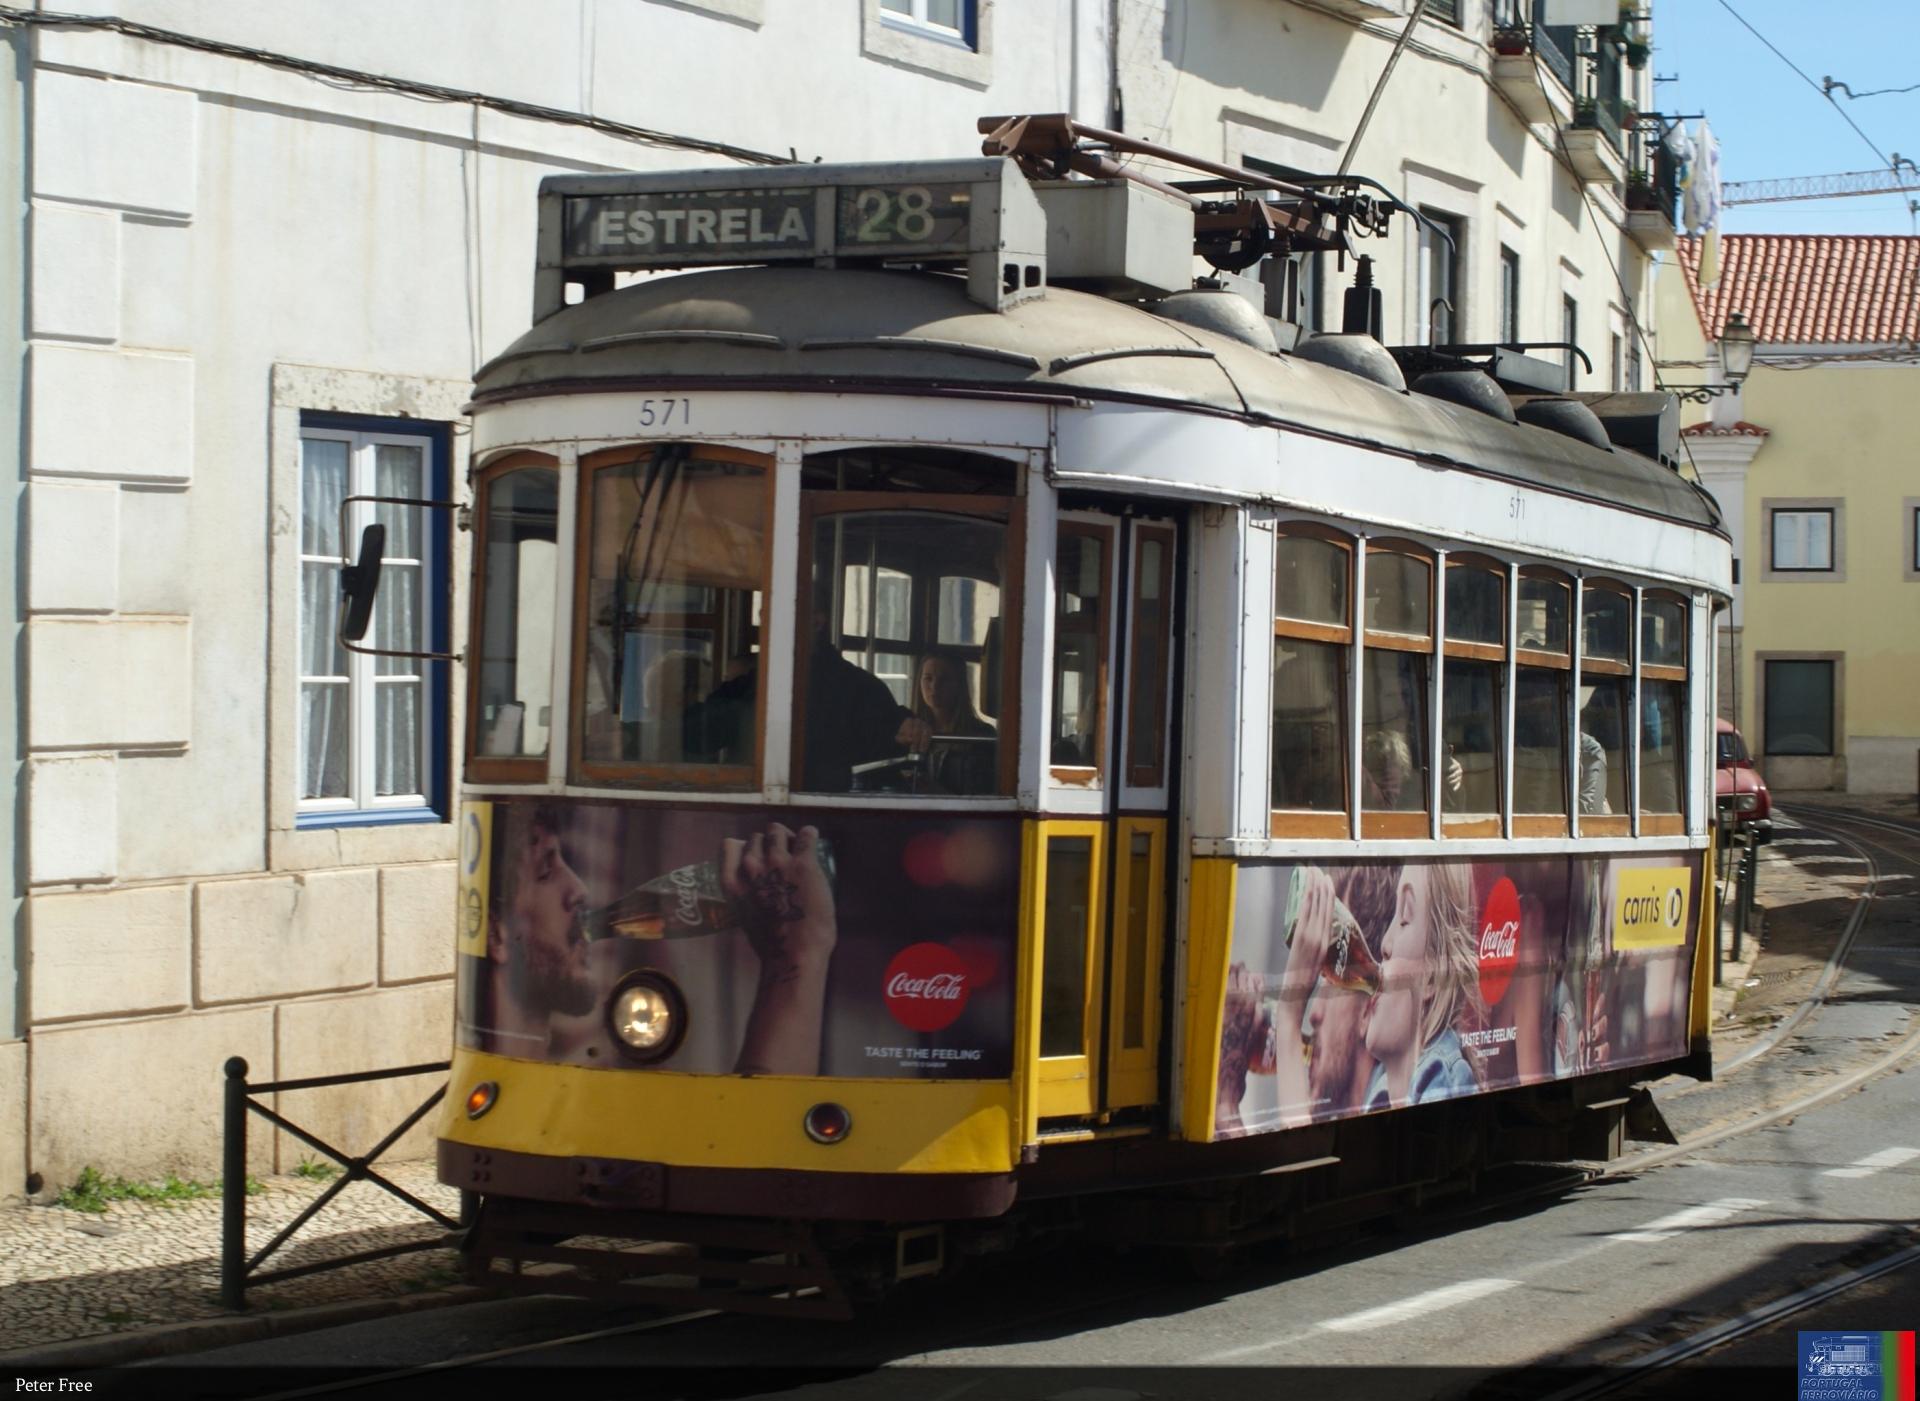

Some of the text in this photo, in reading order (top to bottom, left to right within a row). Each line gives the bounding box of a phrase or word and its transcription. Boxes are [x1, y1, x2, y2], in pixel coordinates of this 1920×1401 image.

[600, 208, 808, 246] ESTRELA
[855, 187, 935, 243] 28
[639, 398, 690, 426] 571
[1509, 496, 1525, 520] 571
[1623, 885, 1660, 926] carris
[1480, 921, 1519, 960] Coca-Cola
[887, 971, 967, 999] Coca-Cola
[1461, 1026, 1517, 1047] TASTE THE FEELING
[864, 1046, 981, 1060] TASTE THE FEELING
